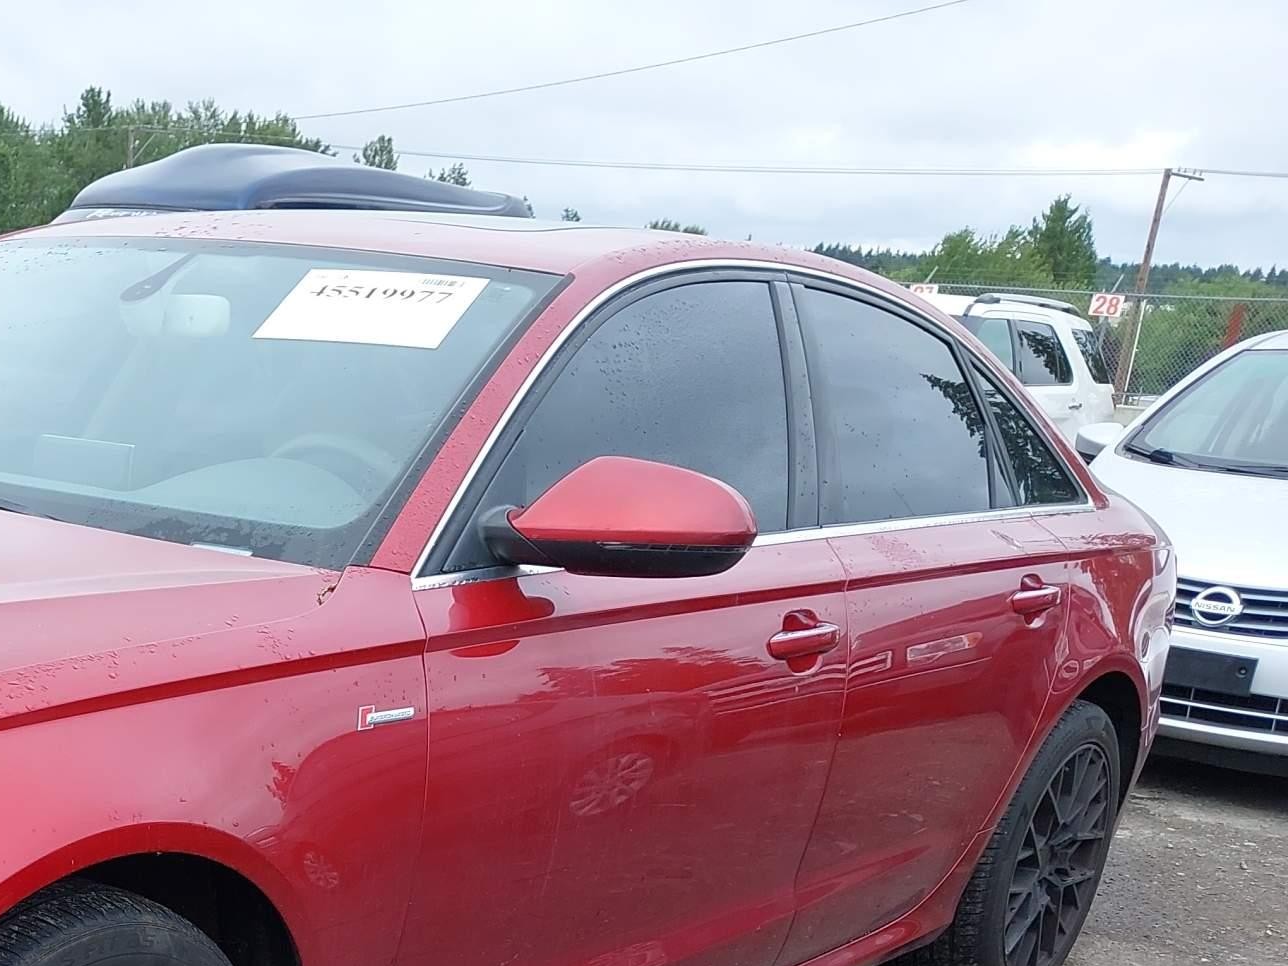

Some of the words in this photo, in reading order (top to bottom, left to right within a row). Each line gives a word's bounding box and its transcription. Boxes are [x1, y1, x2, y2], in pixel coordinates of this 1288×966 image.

[310, 284, 454, 303] 45519977
[1092, 295, 1121, 315] 28
[1194, 601, 1236, 613] NISSAN
